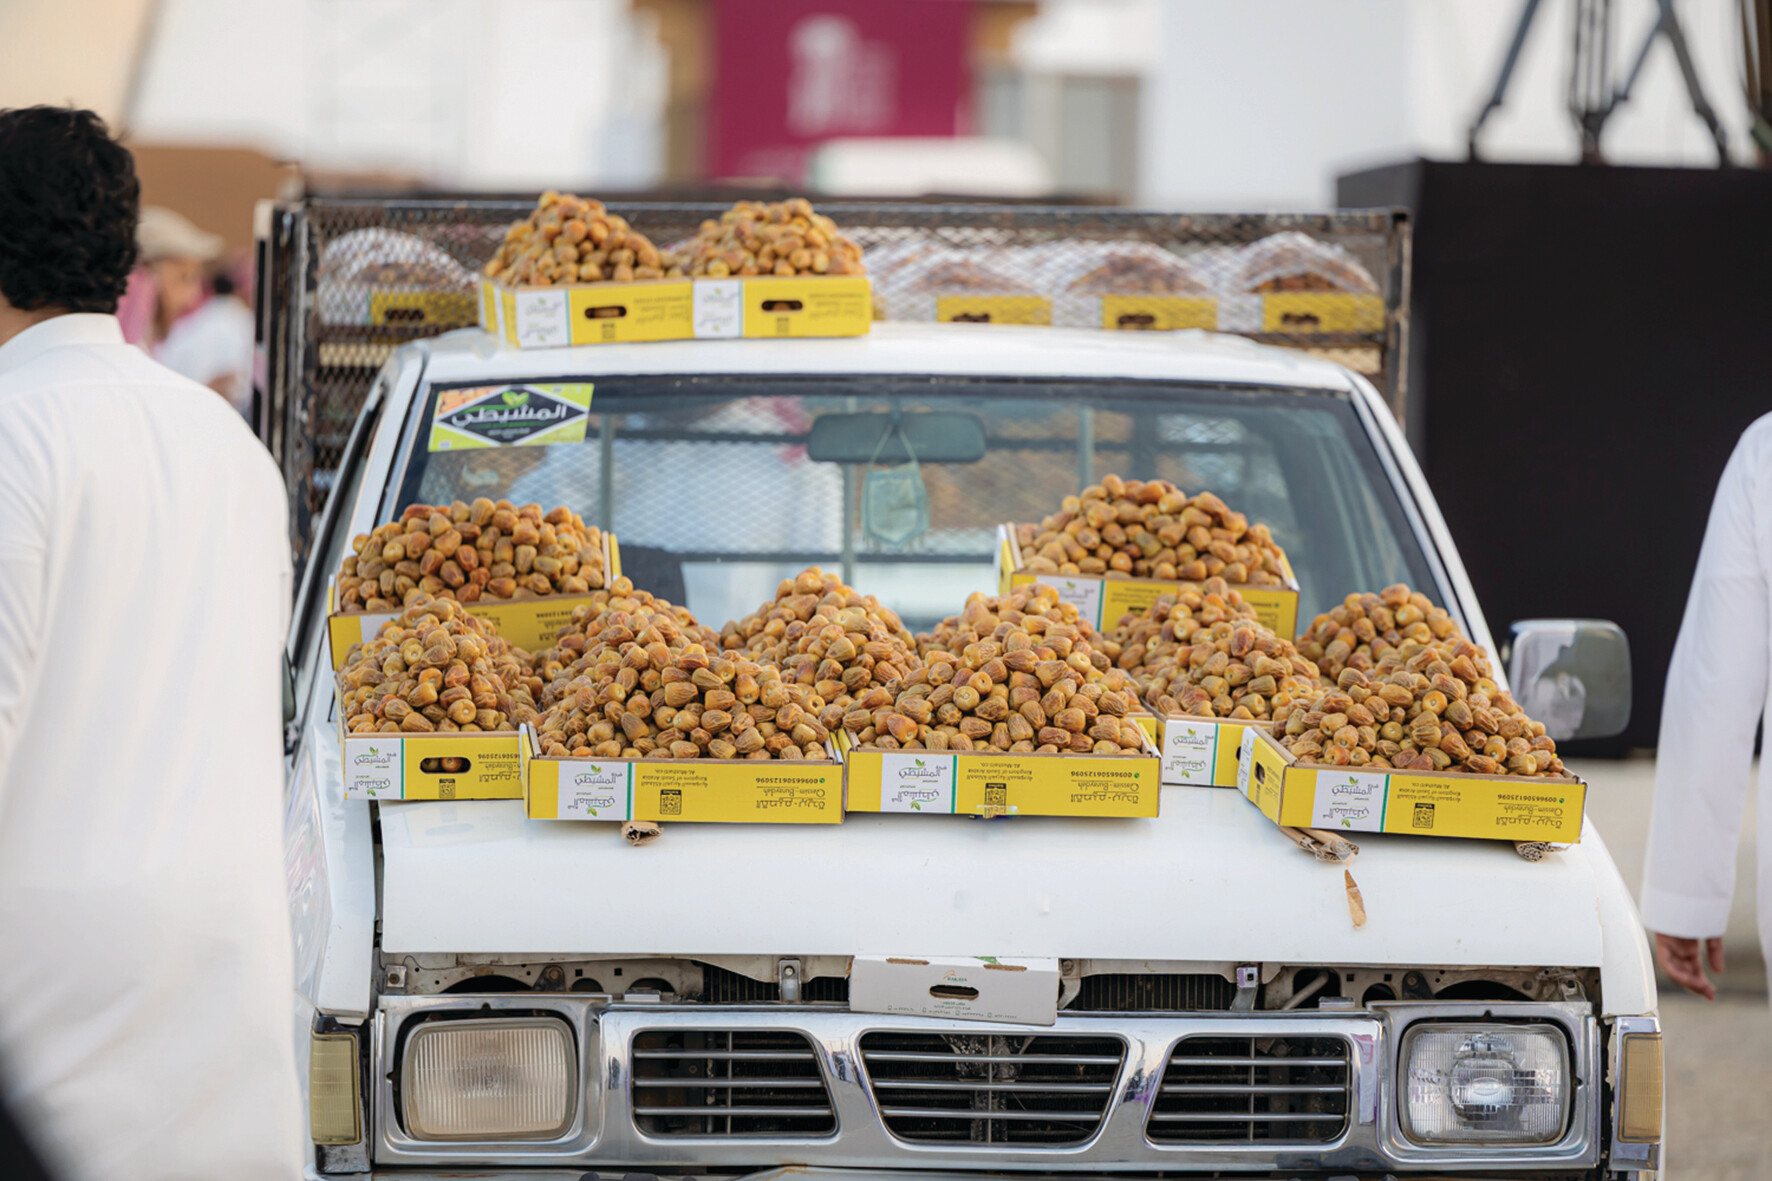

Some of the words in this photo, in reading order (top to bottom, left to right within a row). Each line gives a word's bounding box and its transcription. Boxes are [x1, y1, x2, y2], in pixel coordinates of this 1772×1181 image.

[451, 403, 567, 428] المشيطي
[354, 756, 391, 766] المشيطي
[898, 768, 941, 779] المشيطي
[574, 775, 616, 786] المشيطي
[897, 789, 940, 800] المشيطي
[1331, 785, 1372, 796] المشيطي
[574, 796, 616, 808] المشيطي
[1071, 791, 1107, 803] القصيم
[1112, 792, 1139, 804] بريدة
[1498, 794, 1557, 803] 00966506125096
[756, 798, 793, 809] القصيم
[798, 799, 826, 810] بريدة
[1330, 807, 1370, 818] المشيطي
[1496, 815, 1532, 826] القصيم
[1536, 816, 1563, 829] بريدة
